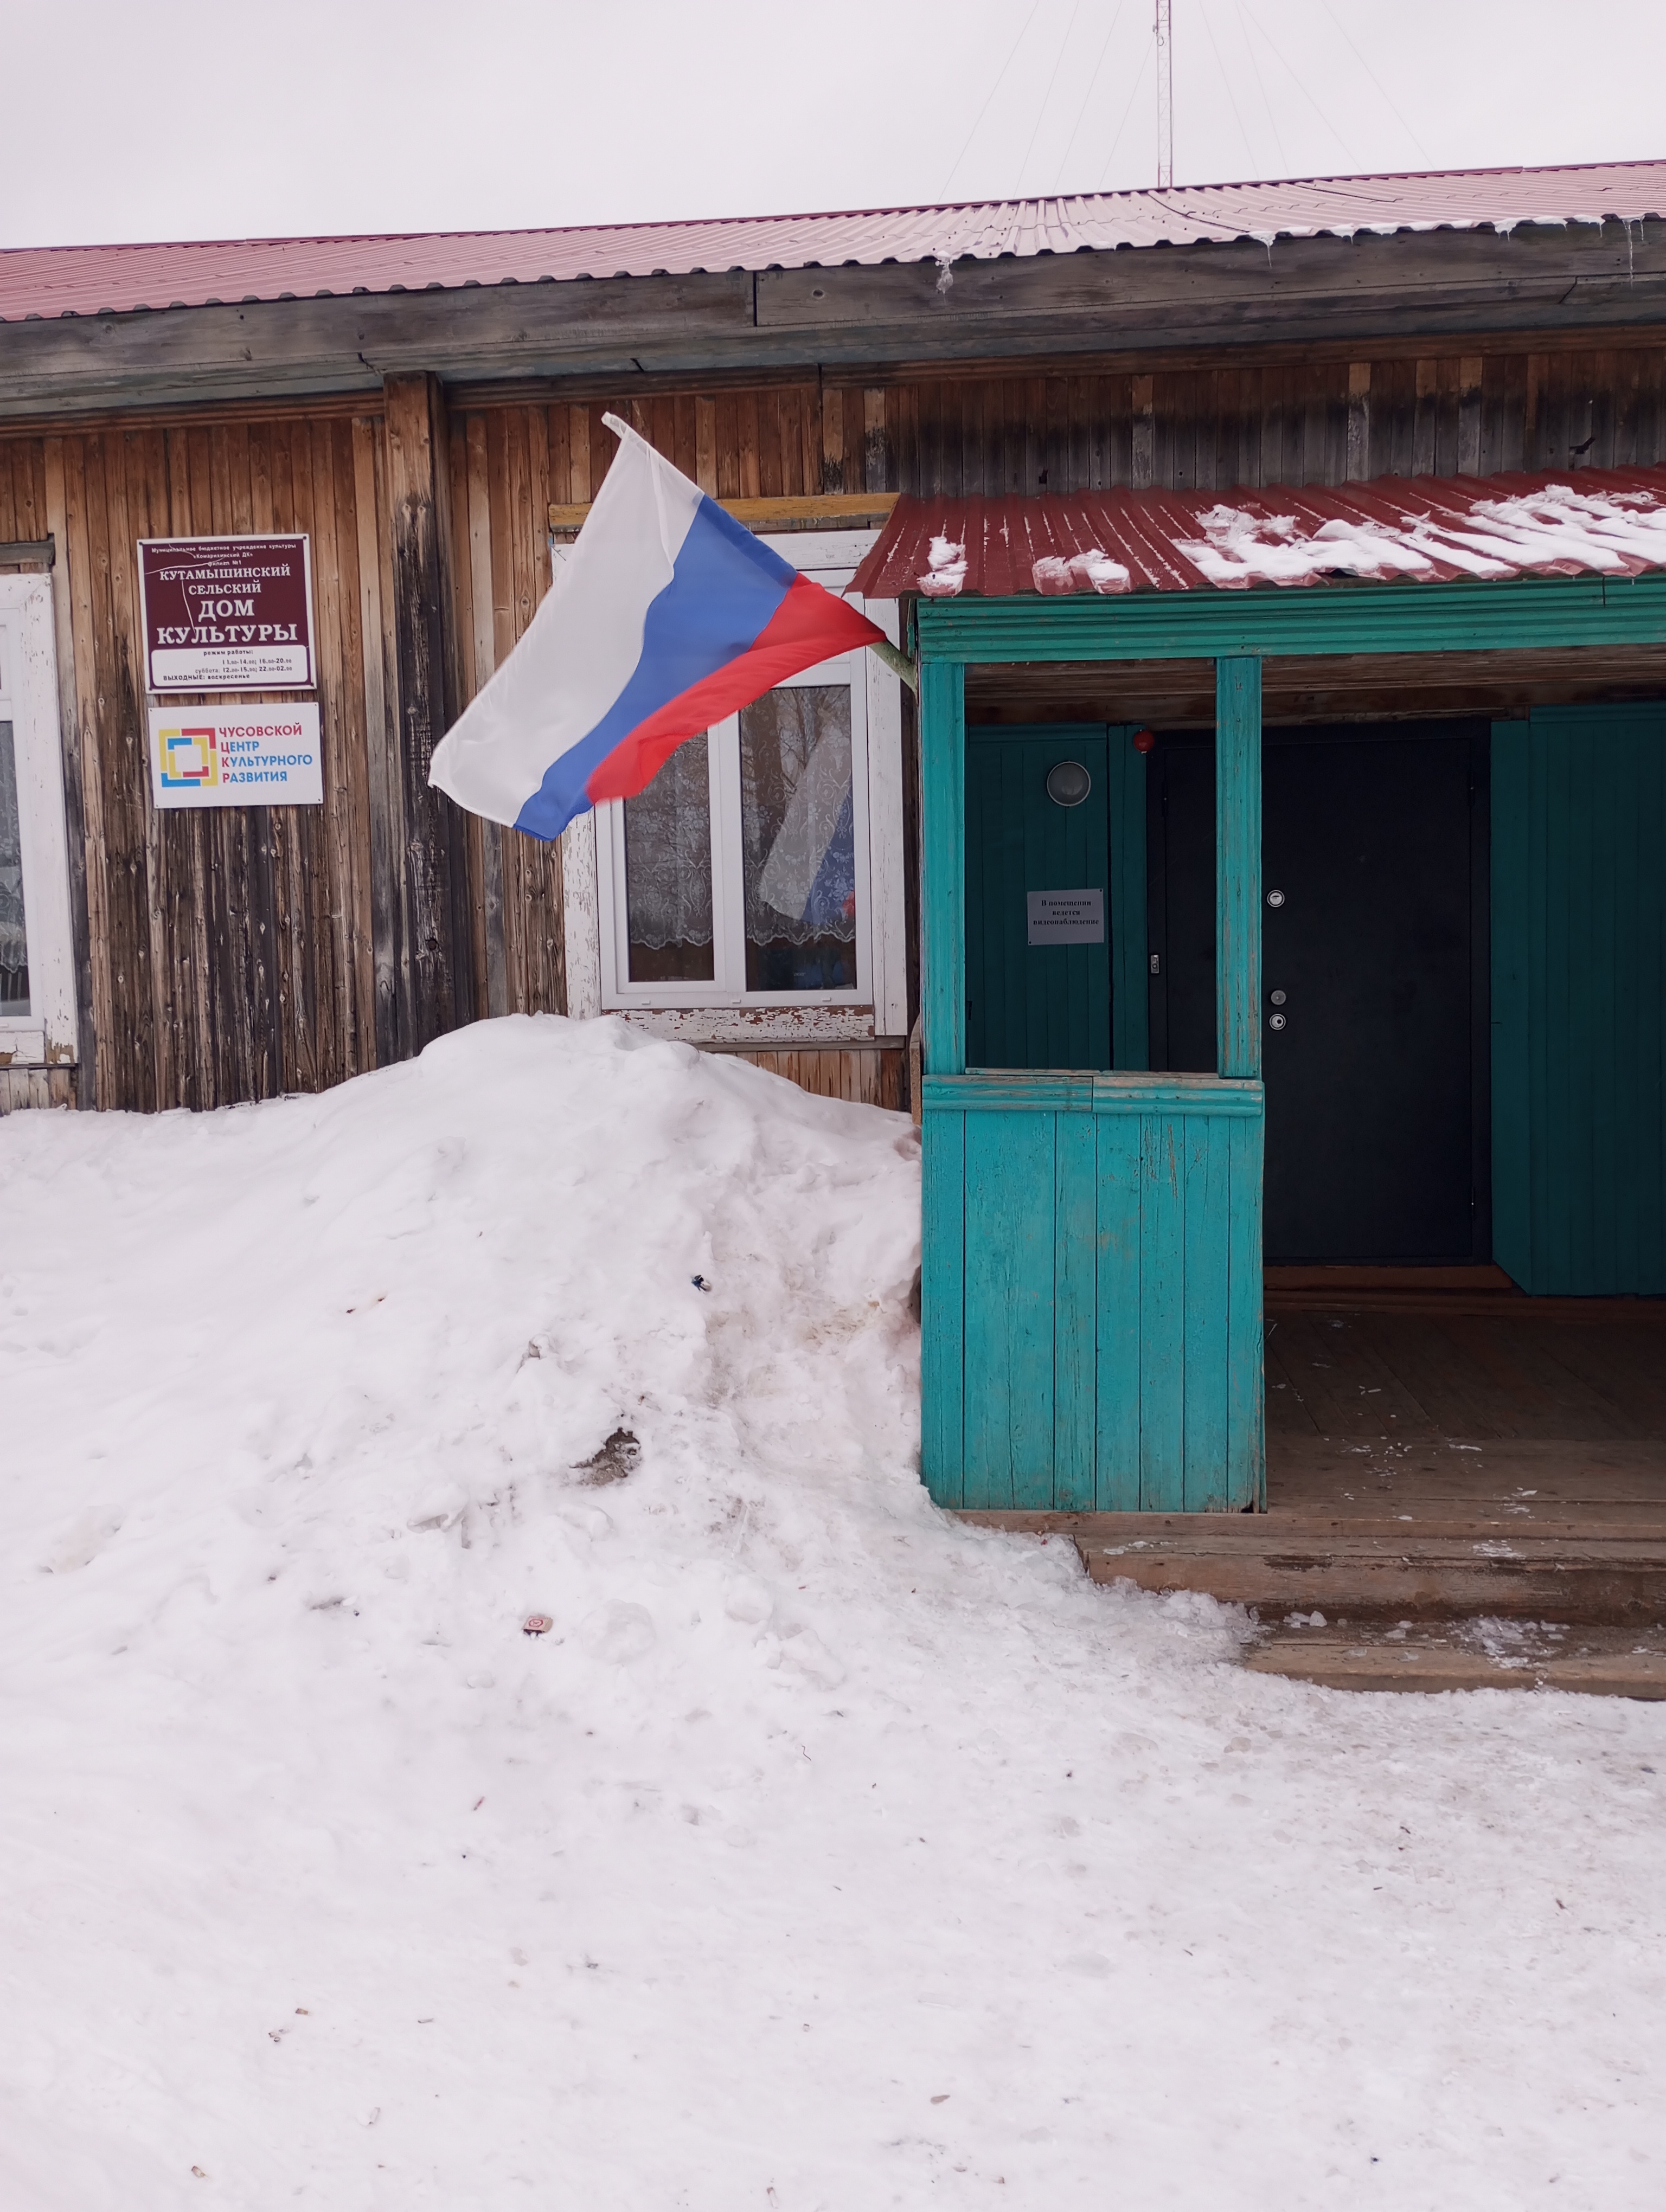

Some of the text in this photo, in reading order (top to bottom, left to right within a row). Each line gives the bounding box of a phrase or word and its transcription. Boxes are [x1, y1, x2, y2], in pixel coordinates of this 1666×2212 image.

[159, 563, 291, 581] КУТАМЫШИНСКИЙ
[188, 580, 261, 595] СЕЛЬСКИЙ
[198, 600, 255, 622] ДОМ
[157, 623, 298, 645] КУЛЬТУРЫ
[219, 722, 302, 737] ЧУСОВСКОЙ
[221, 741, 259, 754] ЦЕНТР
[222, 755, 312, 768] КУЛЬТУРНОГО
[222, 771, 287, 783] РАЗВИТИЯ
